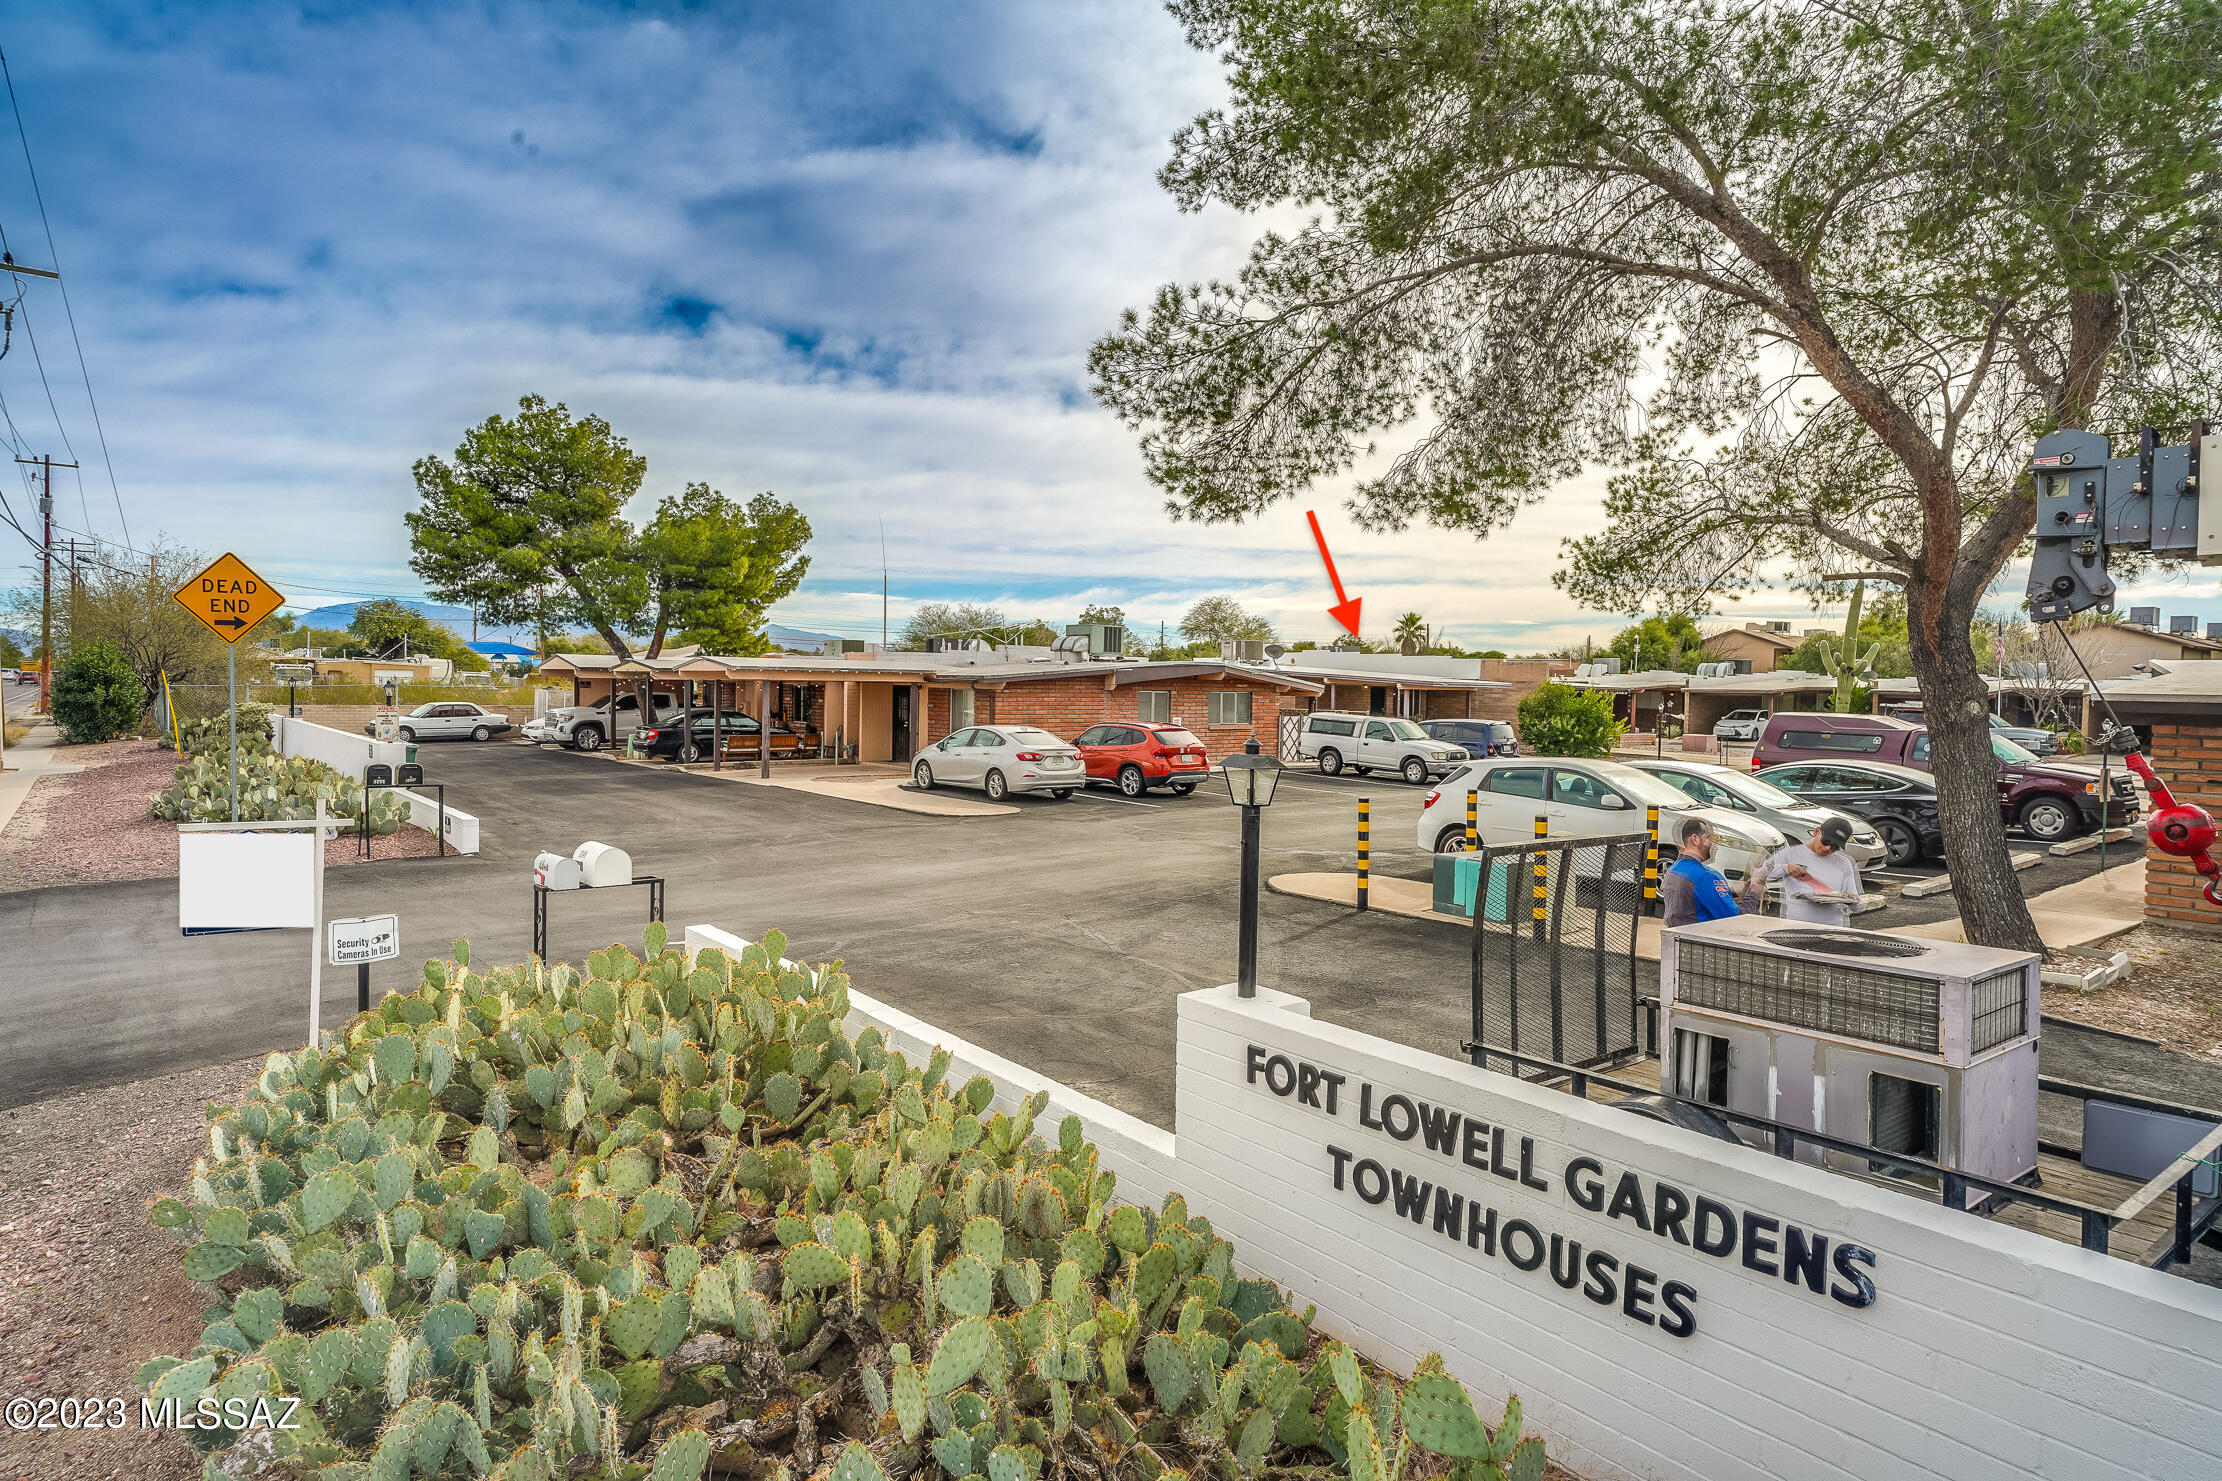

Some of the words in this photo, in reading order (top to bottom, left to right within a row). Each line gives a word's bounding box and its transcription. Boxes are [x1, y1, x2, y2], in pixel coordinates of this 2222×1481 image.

[202, 578, 257, 595] DEAD
[210, 598, 250, 614] END
[337, 937, 370, 949] Security
[337, 949, 370, 960] Cameras
[371, 947, 378, 957] In
[379, 945, 392, 955] Use
[1246, 1043, 1346, 1116] FORT
[1359, 1082, 1549, 1193] LOWELL
[1564, 1156, 1878, 1309] GARDENS
[1326, 1144, 1698, 1338] TOWNHOUSES
